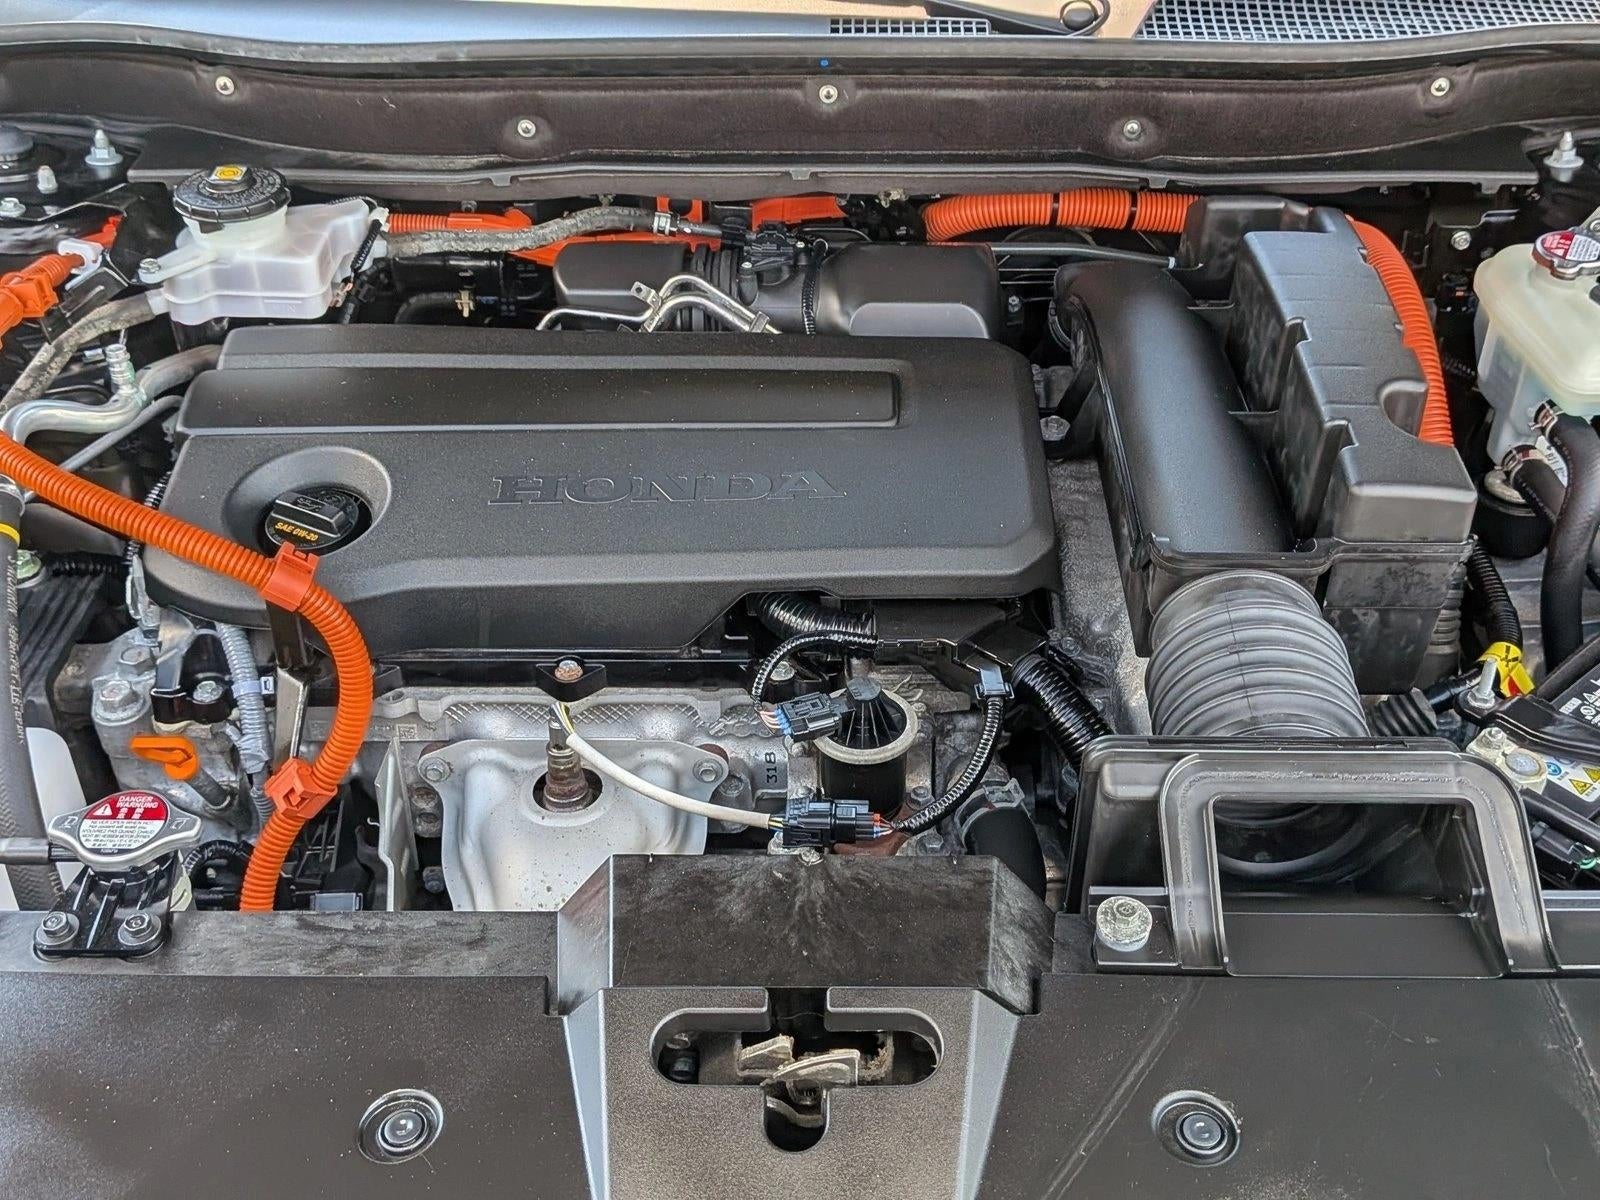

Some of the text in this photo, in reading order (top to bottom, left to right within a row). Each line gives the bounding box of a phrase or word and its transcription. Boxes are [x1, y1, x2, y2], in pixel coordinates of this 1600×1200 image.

[488, 470, 847, 505] HONDA
[275, 522, 295, 533] SAE
[293, 529, 319, 541] 0W-20
